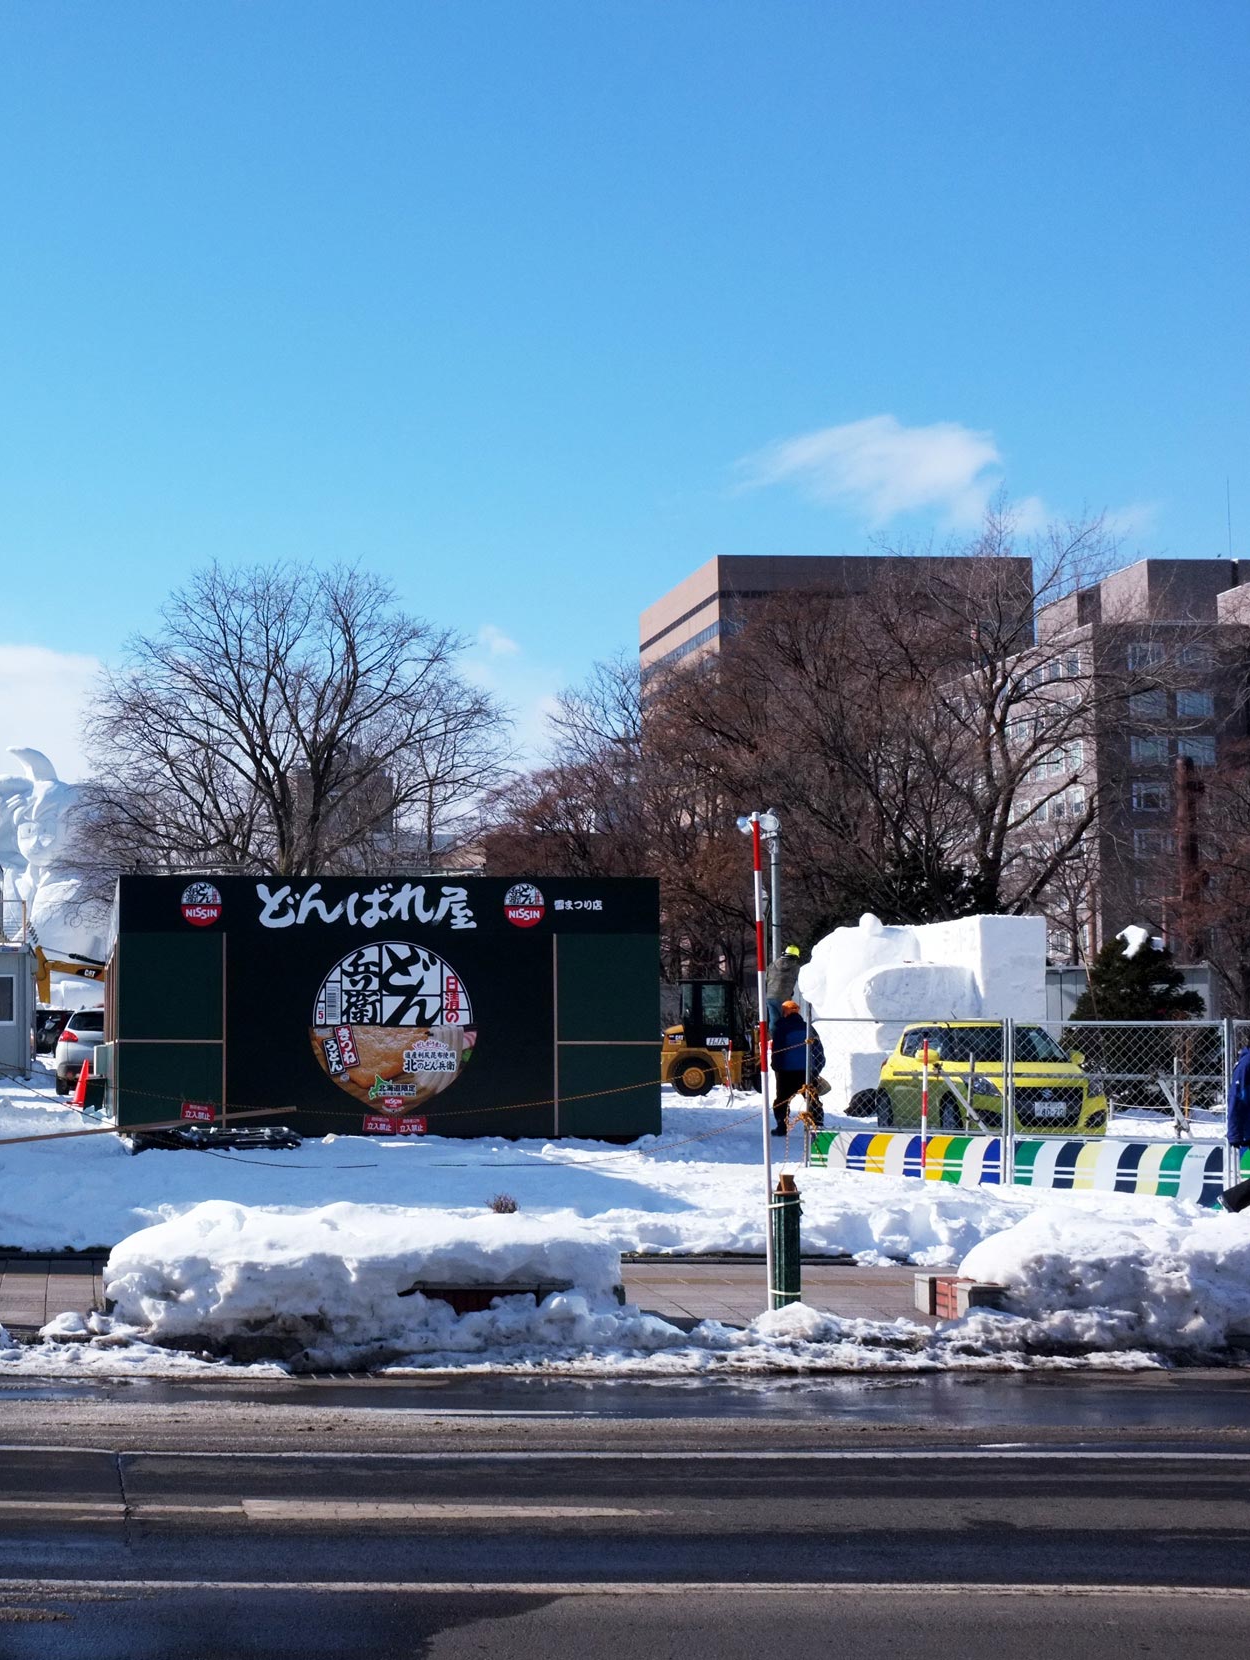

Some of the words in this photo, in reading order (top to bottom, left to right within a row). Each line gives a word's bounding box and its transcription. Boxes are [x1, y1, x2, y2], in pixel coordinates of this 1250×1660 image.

[256, 882, 478, 930] どんばれ屋
[185, 907, 217, 920] NISSIN
[508, 908, 541, 920] NISSIN
[84, 969, 96, 978] CAT
[445, 975, 460, 1023] 日清の
[338, 1027, 357, 1065] きつね
[325, 1040, 343, 1073] うどん
[185, 1110, 210, 1120] 立入禁止
[367, 1122, 392, 1132] 立入禁止
[400, 1124, 424, 1132] 立入禁止
